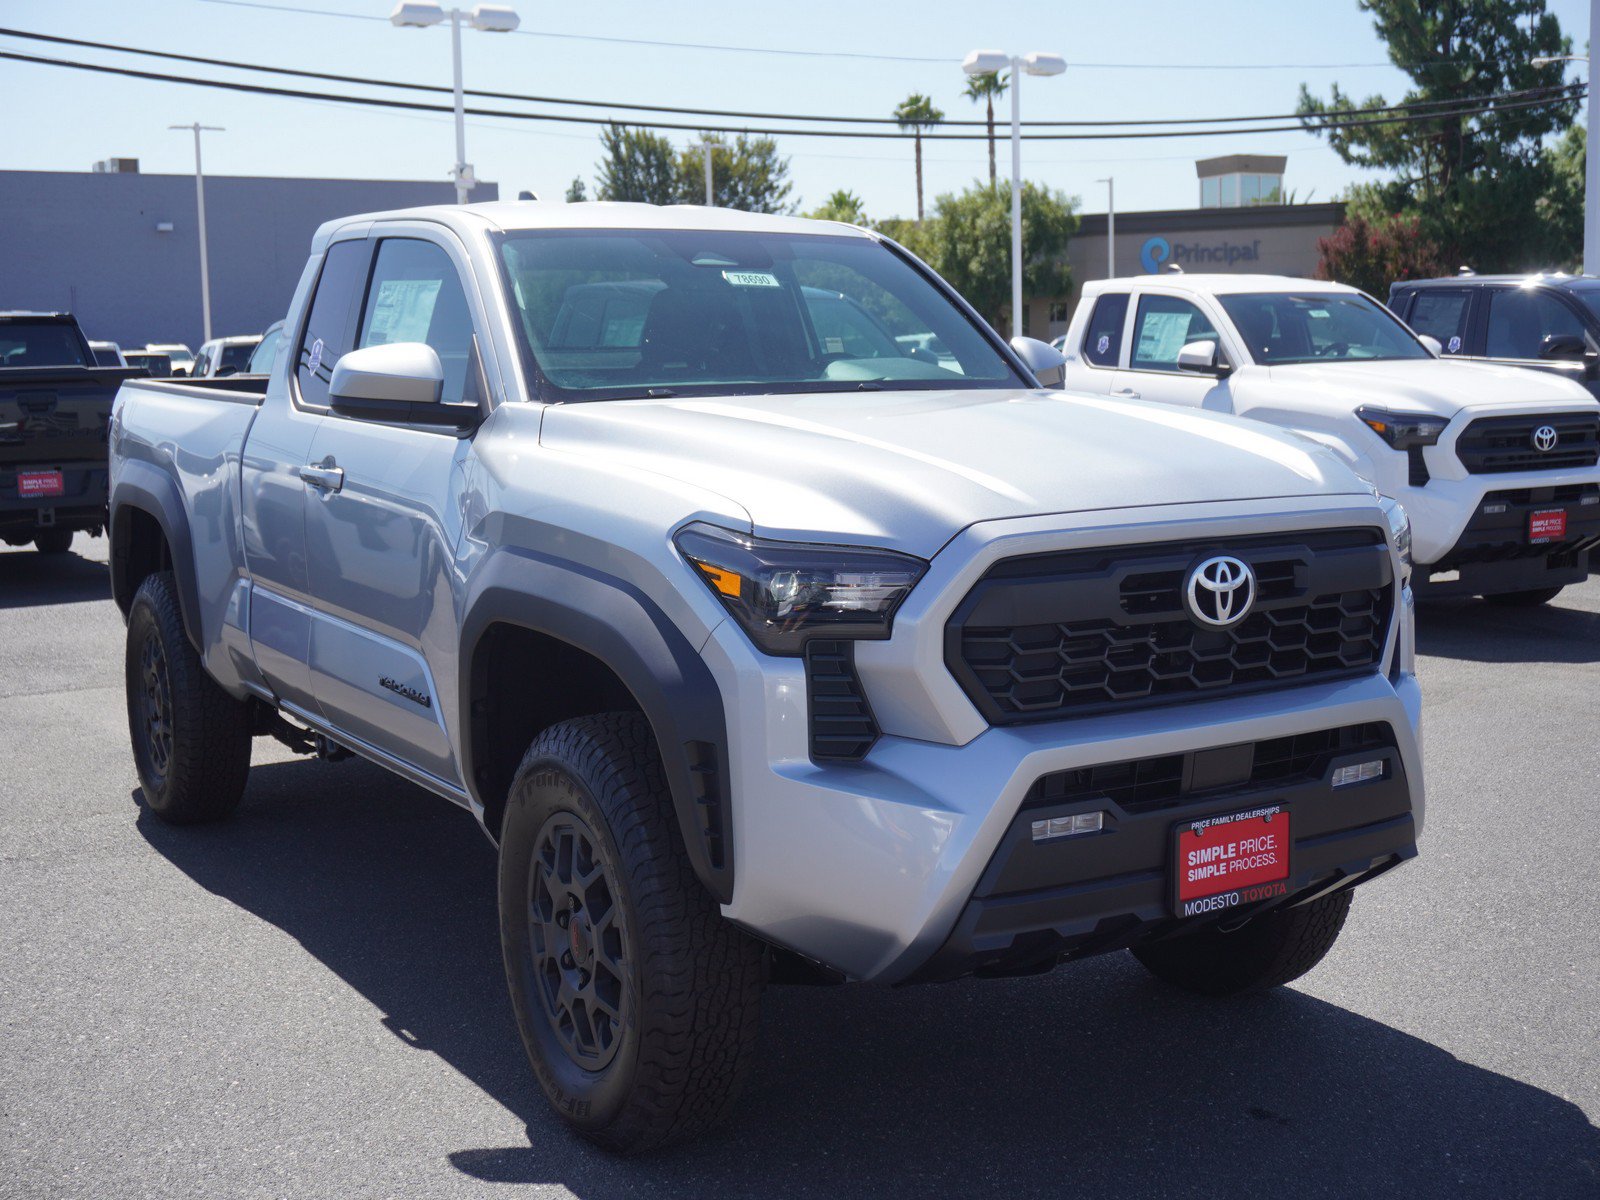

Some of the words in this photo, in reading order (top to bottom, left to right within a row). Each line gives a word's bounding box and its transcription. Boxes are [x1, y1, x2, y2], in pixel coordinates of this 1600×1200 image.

[1173, 239, 1259, 266] Principal
[734, 274, 770, 284] 78690
[1191, 820, 1210, 830] PRICE
[1211, 815, 1235, 826] FAMILY
[1235, 806, 1280, 821] DEALERSHIPS
[1188, 843, 1236, 866] SIMPLE
[1240, 835, 1277, 855] PRICE.
[1188, 863, 1226, 881] SIMPLE
[1230, 853, 1277, 872] PROCESS.
[1185, 893, 1238, 916] MODESTO
[1243, 883, 1286, 902] TOYOTA
